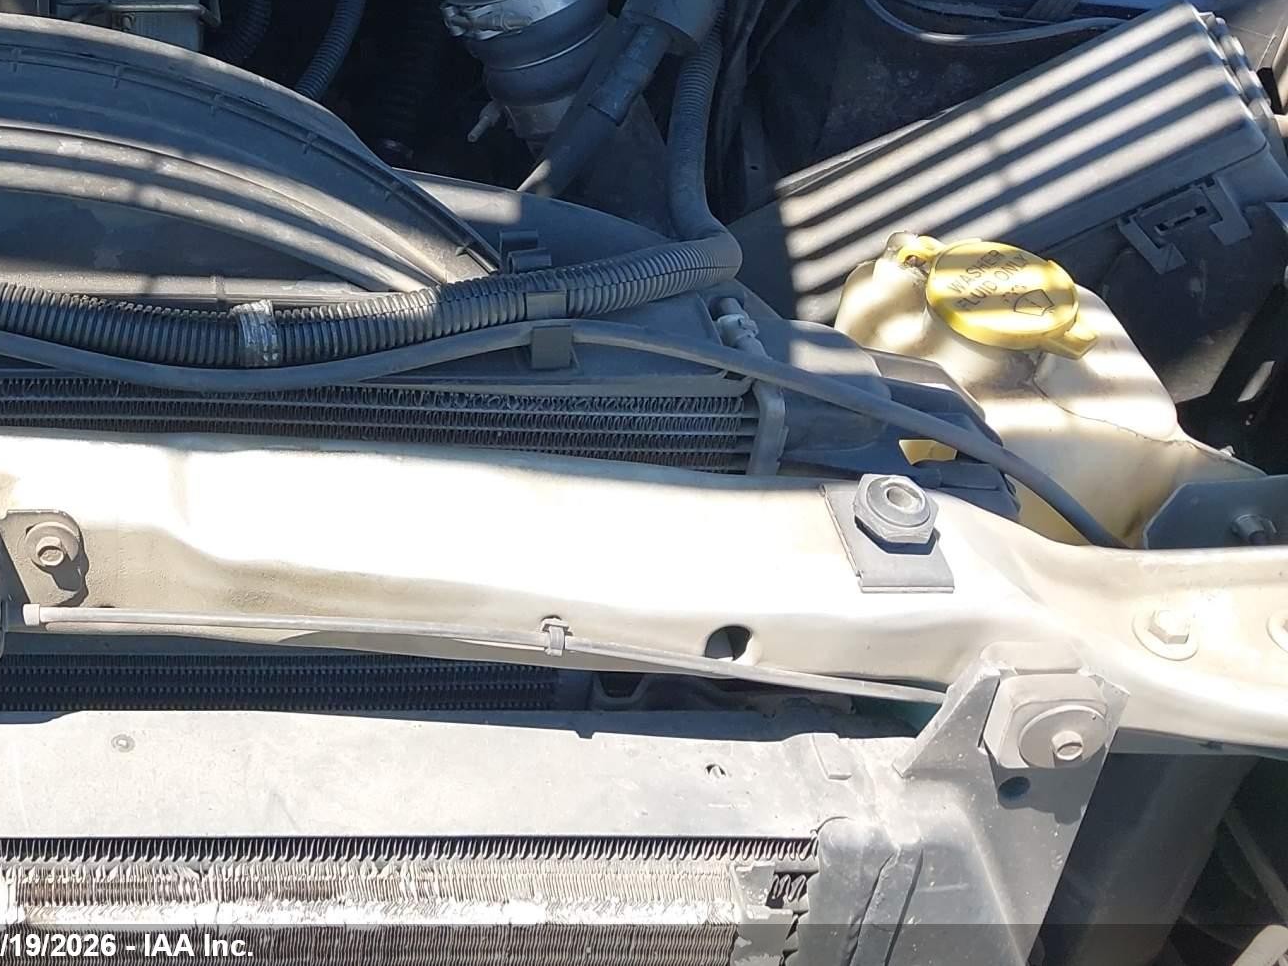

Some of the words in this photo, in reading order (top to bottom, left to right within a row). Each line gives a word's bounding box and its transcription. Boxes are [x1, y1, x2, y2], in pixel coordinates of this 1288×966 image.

[947, 249, 1005, 294] WASHER
[954, 280, 999, 312] FLUID
[994, 253, 1029, 282] ONLY
